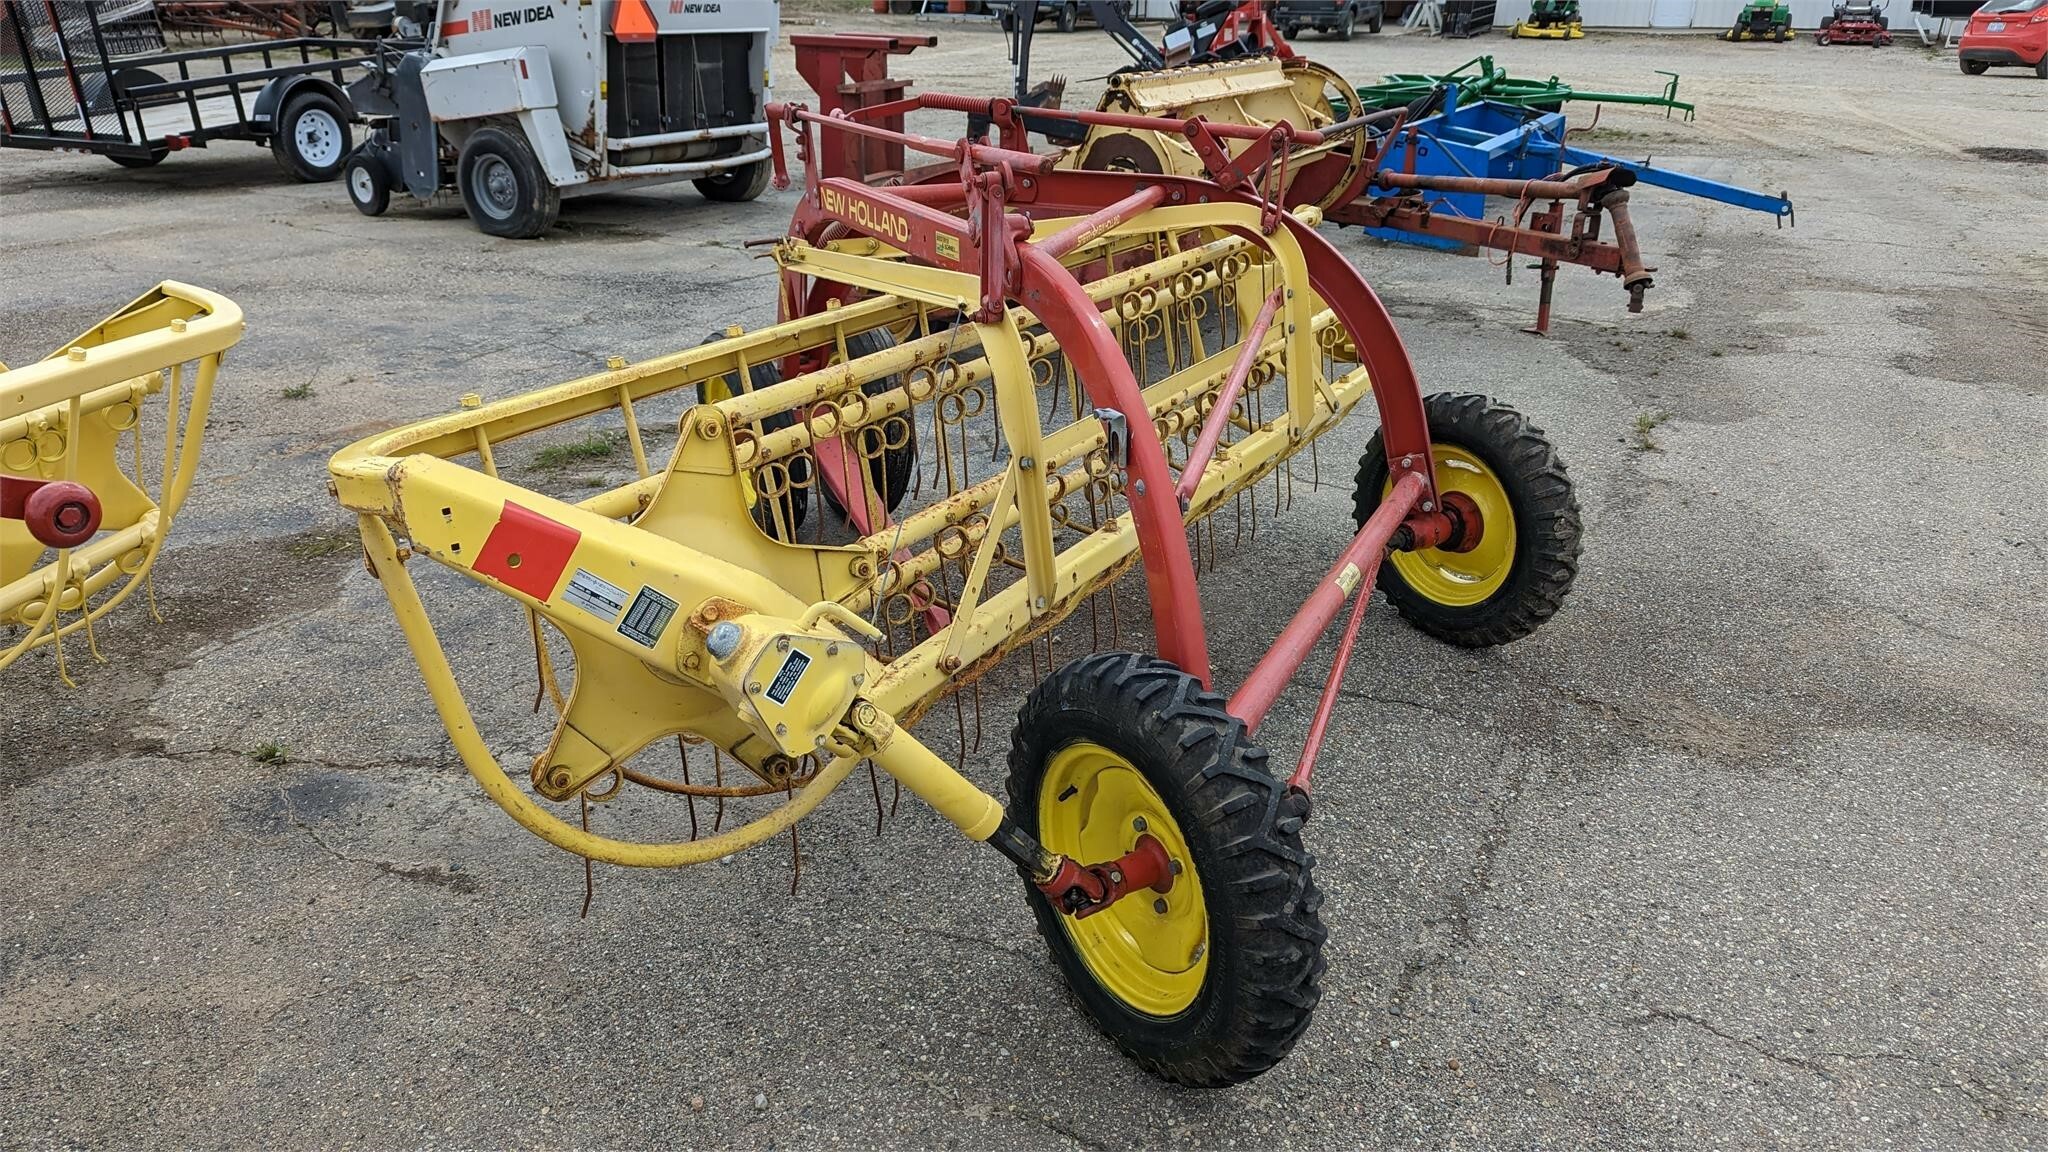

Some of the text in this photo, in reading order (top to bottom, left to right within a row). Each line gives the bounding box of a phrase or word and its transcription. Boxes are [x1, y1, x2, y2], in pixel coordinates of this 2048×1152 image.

[494, 10, 521, 28] NEW
[524, 5, 554, 24] IDEA
[684, 4, 702, 14] NEW
[703, 3, 721, 13] IDEA
[820, 187, 908, 243] NEW HOLLAND
